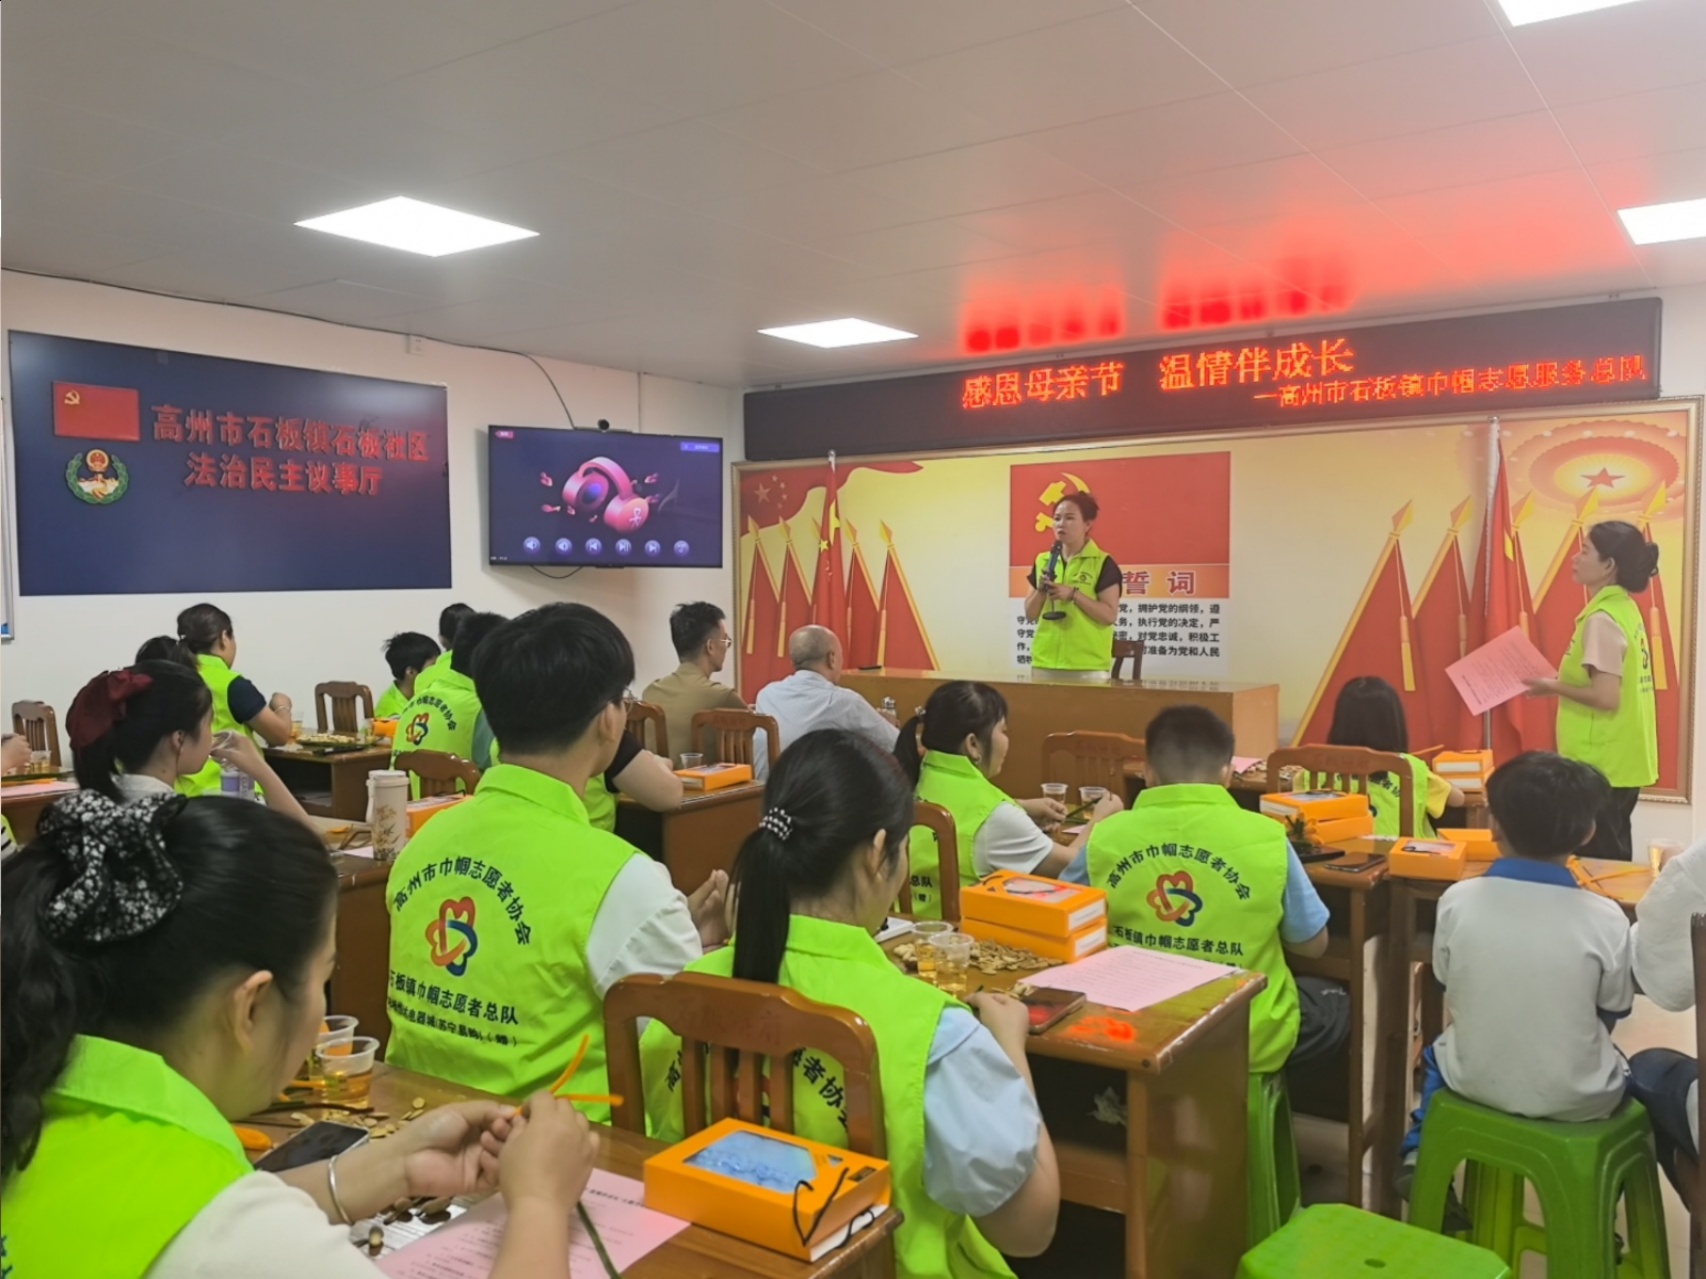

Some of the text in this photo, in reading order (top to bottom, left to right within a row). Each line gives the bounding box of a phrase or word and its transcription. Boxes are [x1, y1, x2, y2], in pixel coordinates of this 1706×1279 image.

[962, 337, 1355, 410] 感恩母亲节 温情伴成长
[151, 403, 429, 462] 高州市石板镇石板社区
[184, 451, 383, 496] 法治民主议事厅
[393, 855, 532, 946] 高州市巾帼志愿者协会
[1106, 842, 1251, 901] 高州市巾帼志愿者协会
[1113, 925, 1244, 957] 石板镇巾帼志愿者总队
